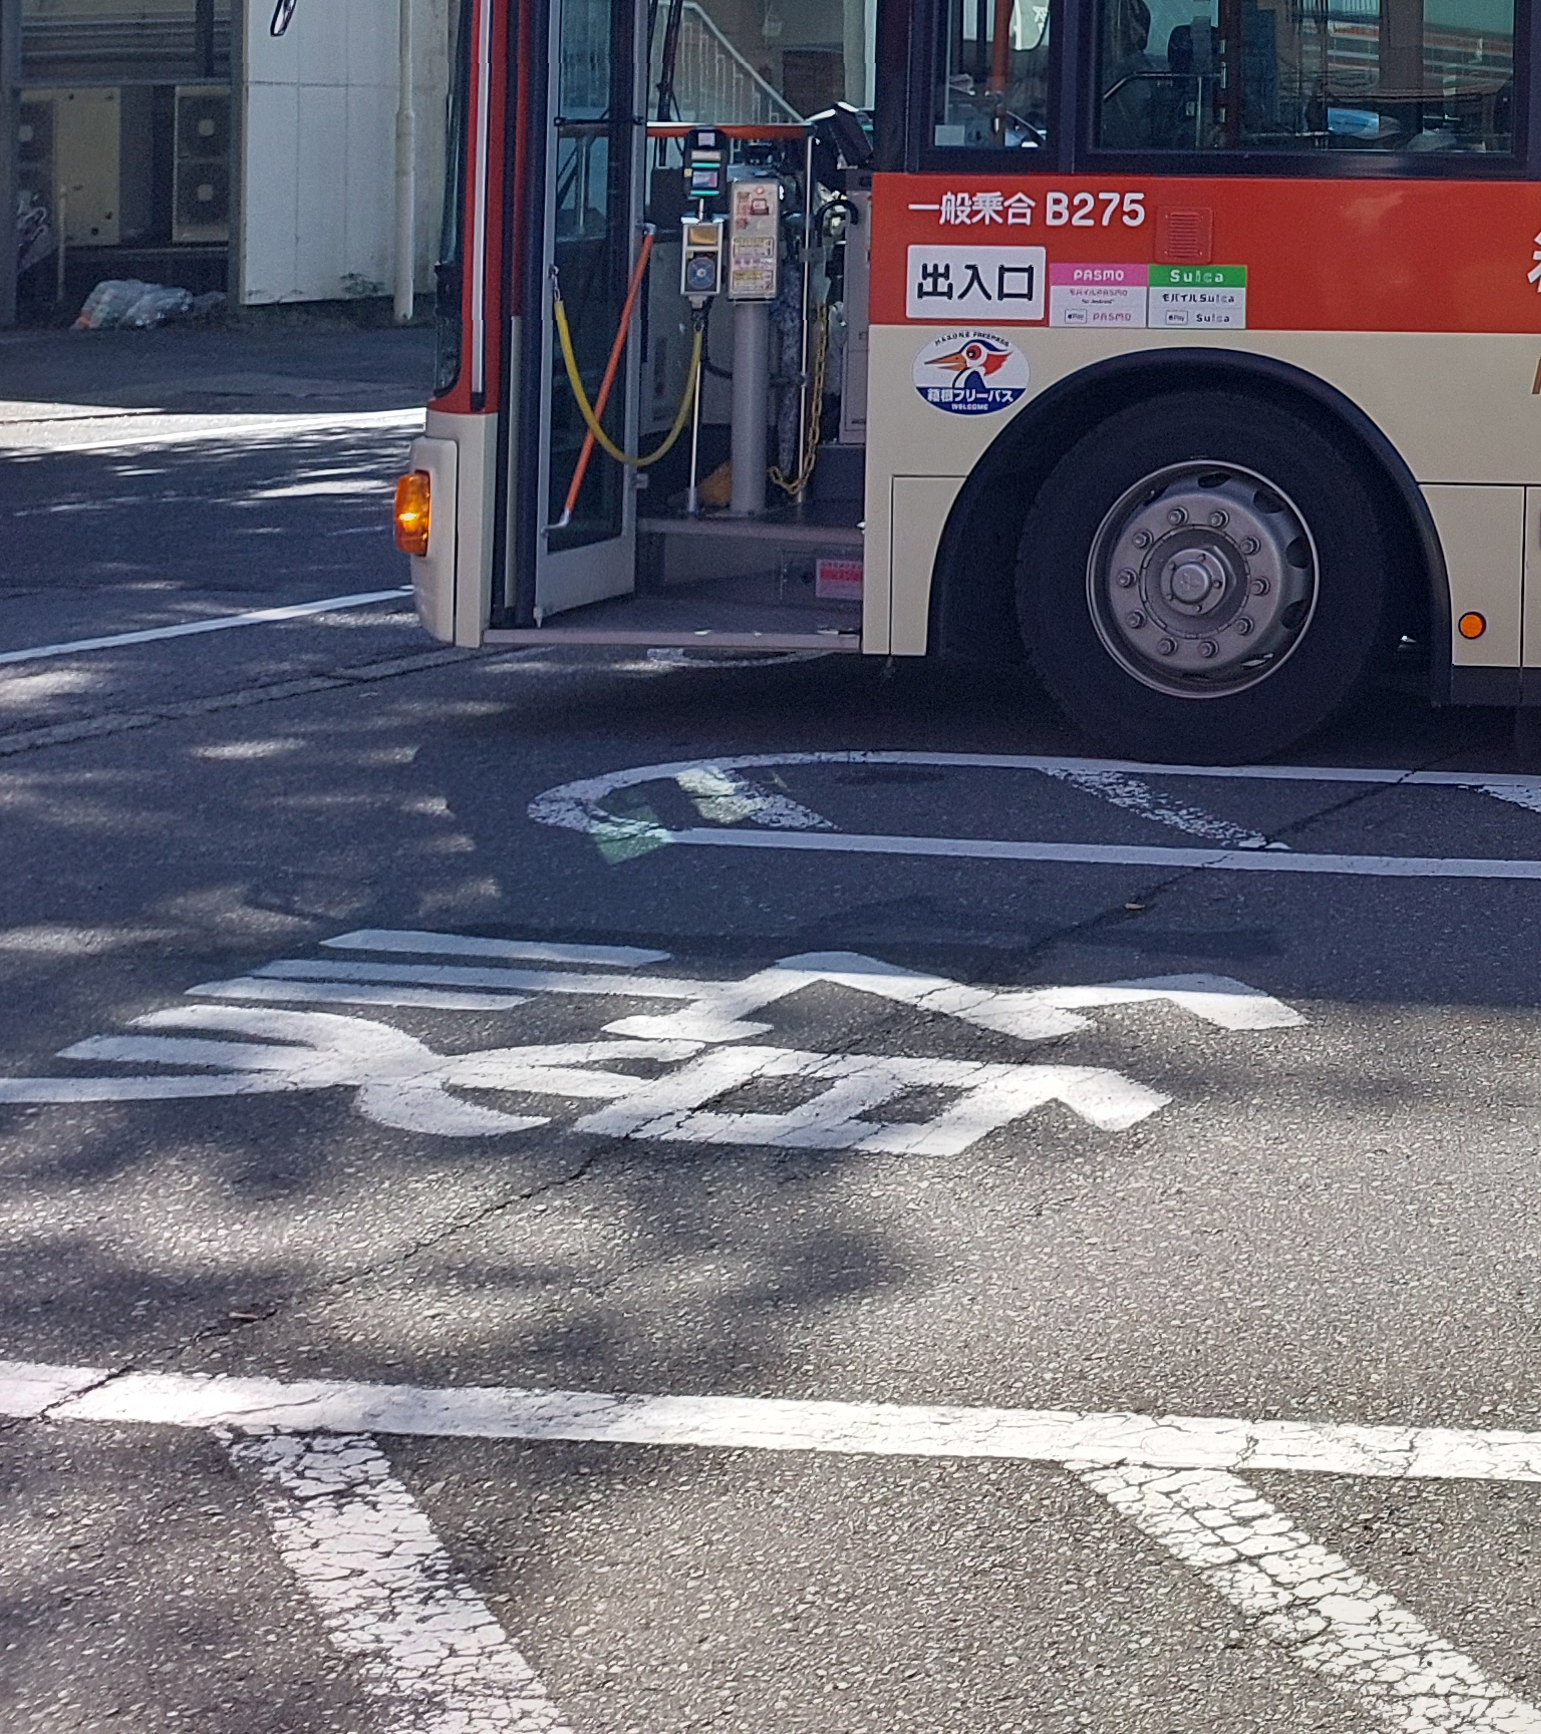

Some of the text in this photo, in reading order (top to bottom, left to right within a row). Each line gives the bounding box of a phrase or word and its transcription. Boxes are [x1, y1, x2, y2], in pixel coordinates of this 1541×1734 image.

[907, 191, 1146, 228] 一般乗合 B275
[916, 262, 1035, 302] 出入口
[1073, 269, 1125, 282] PASMO
[1169, 269, 1224, 283] Suica
[1092, 312, 1132, 322] PASMO
[1195, 312, 1231, 323] Suica
